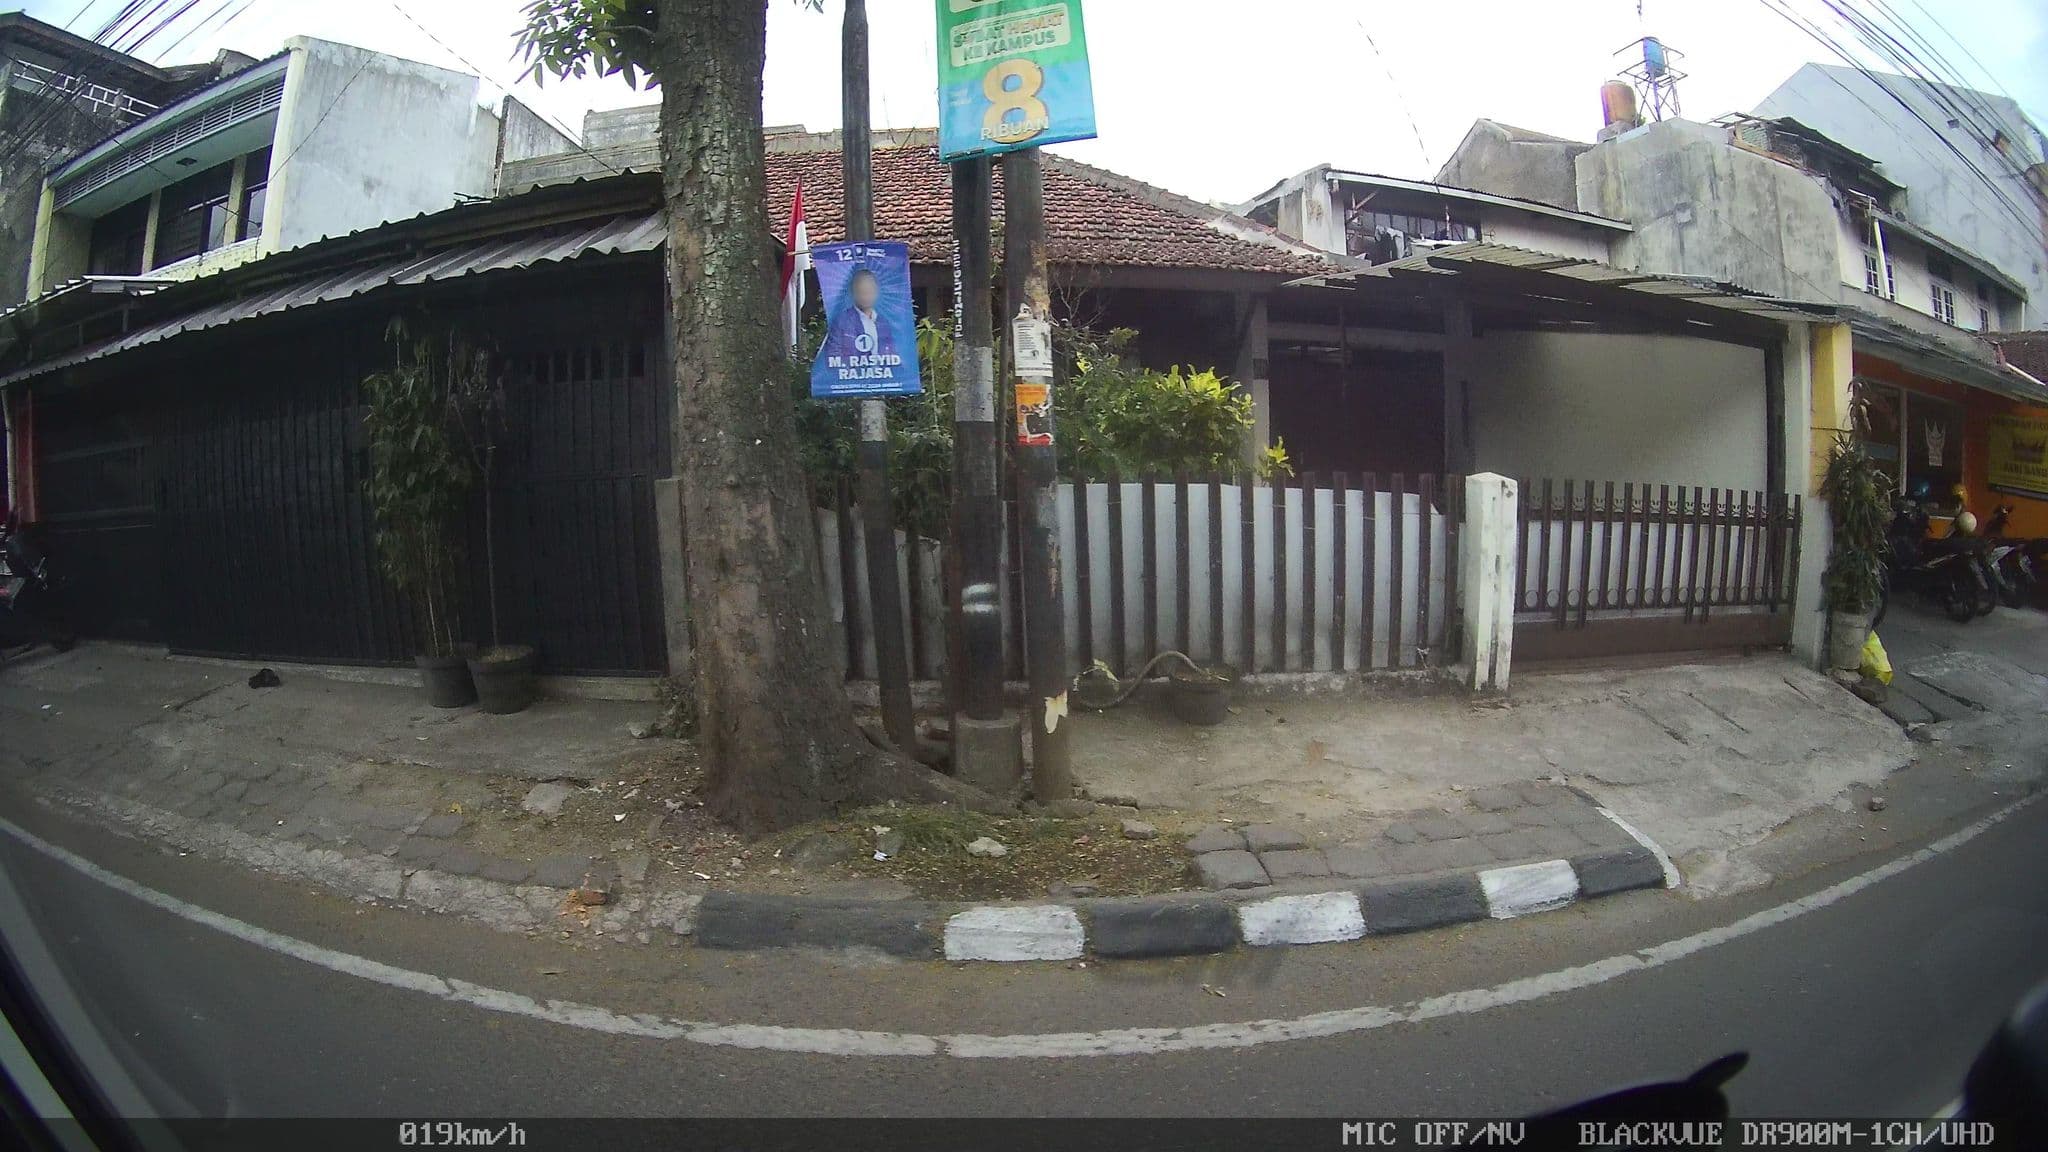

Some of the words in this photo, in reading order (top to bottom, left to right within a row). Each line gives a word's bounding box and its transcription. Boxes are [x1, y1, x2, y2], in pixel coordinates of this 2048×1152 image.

[964, 44, 984, 61] KE
[986, 29, 1056, 56] KAMPUS
[983, 58, 1048, 143] 8
[981, 116, 1049, 140] RIBUAN
[836, 249, 853, 261] 12
[828, 355, 846, 368] M.
[849, 354, 902, 367] RASYID
[838, 367, 893, 380] RAJASA
